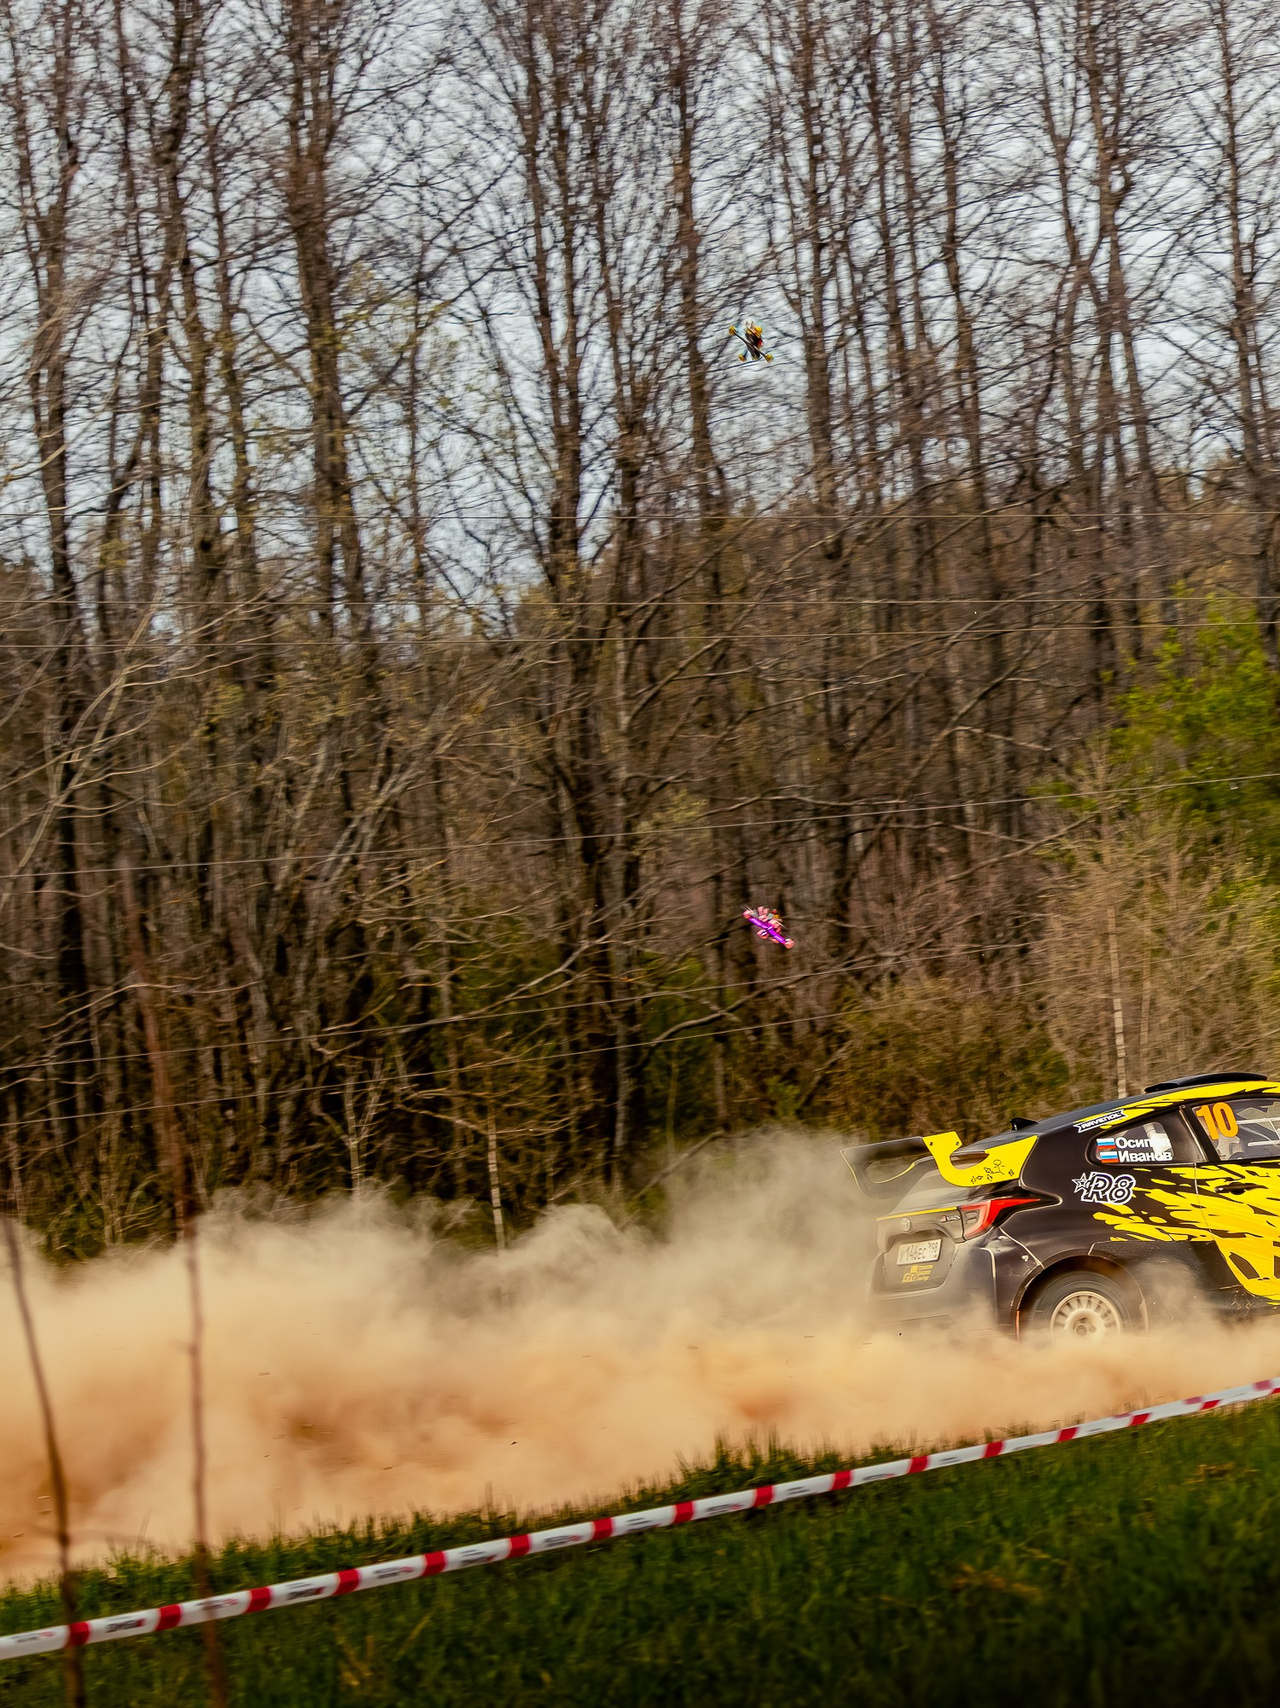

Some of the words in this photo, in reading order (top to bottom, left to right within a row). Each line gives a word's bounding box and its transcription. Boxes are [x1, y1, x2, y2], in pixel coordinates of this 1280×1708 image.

[1081, 1111, 1123, 1129] RAVENOL
[1196, 1102, 1239, 1139] 10
[1115, 1137, 1170, 1149] Осип
[1117, 1150, 1173, 1163] Иванов
[1080, 1171, 1137, 1206] R8
